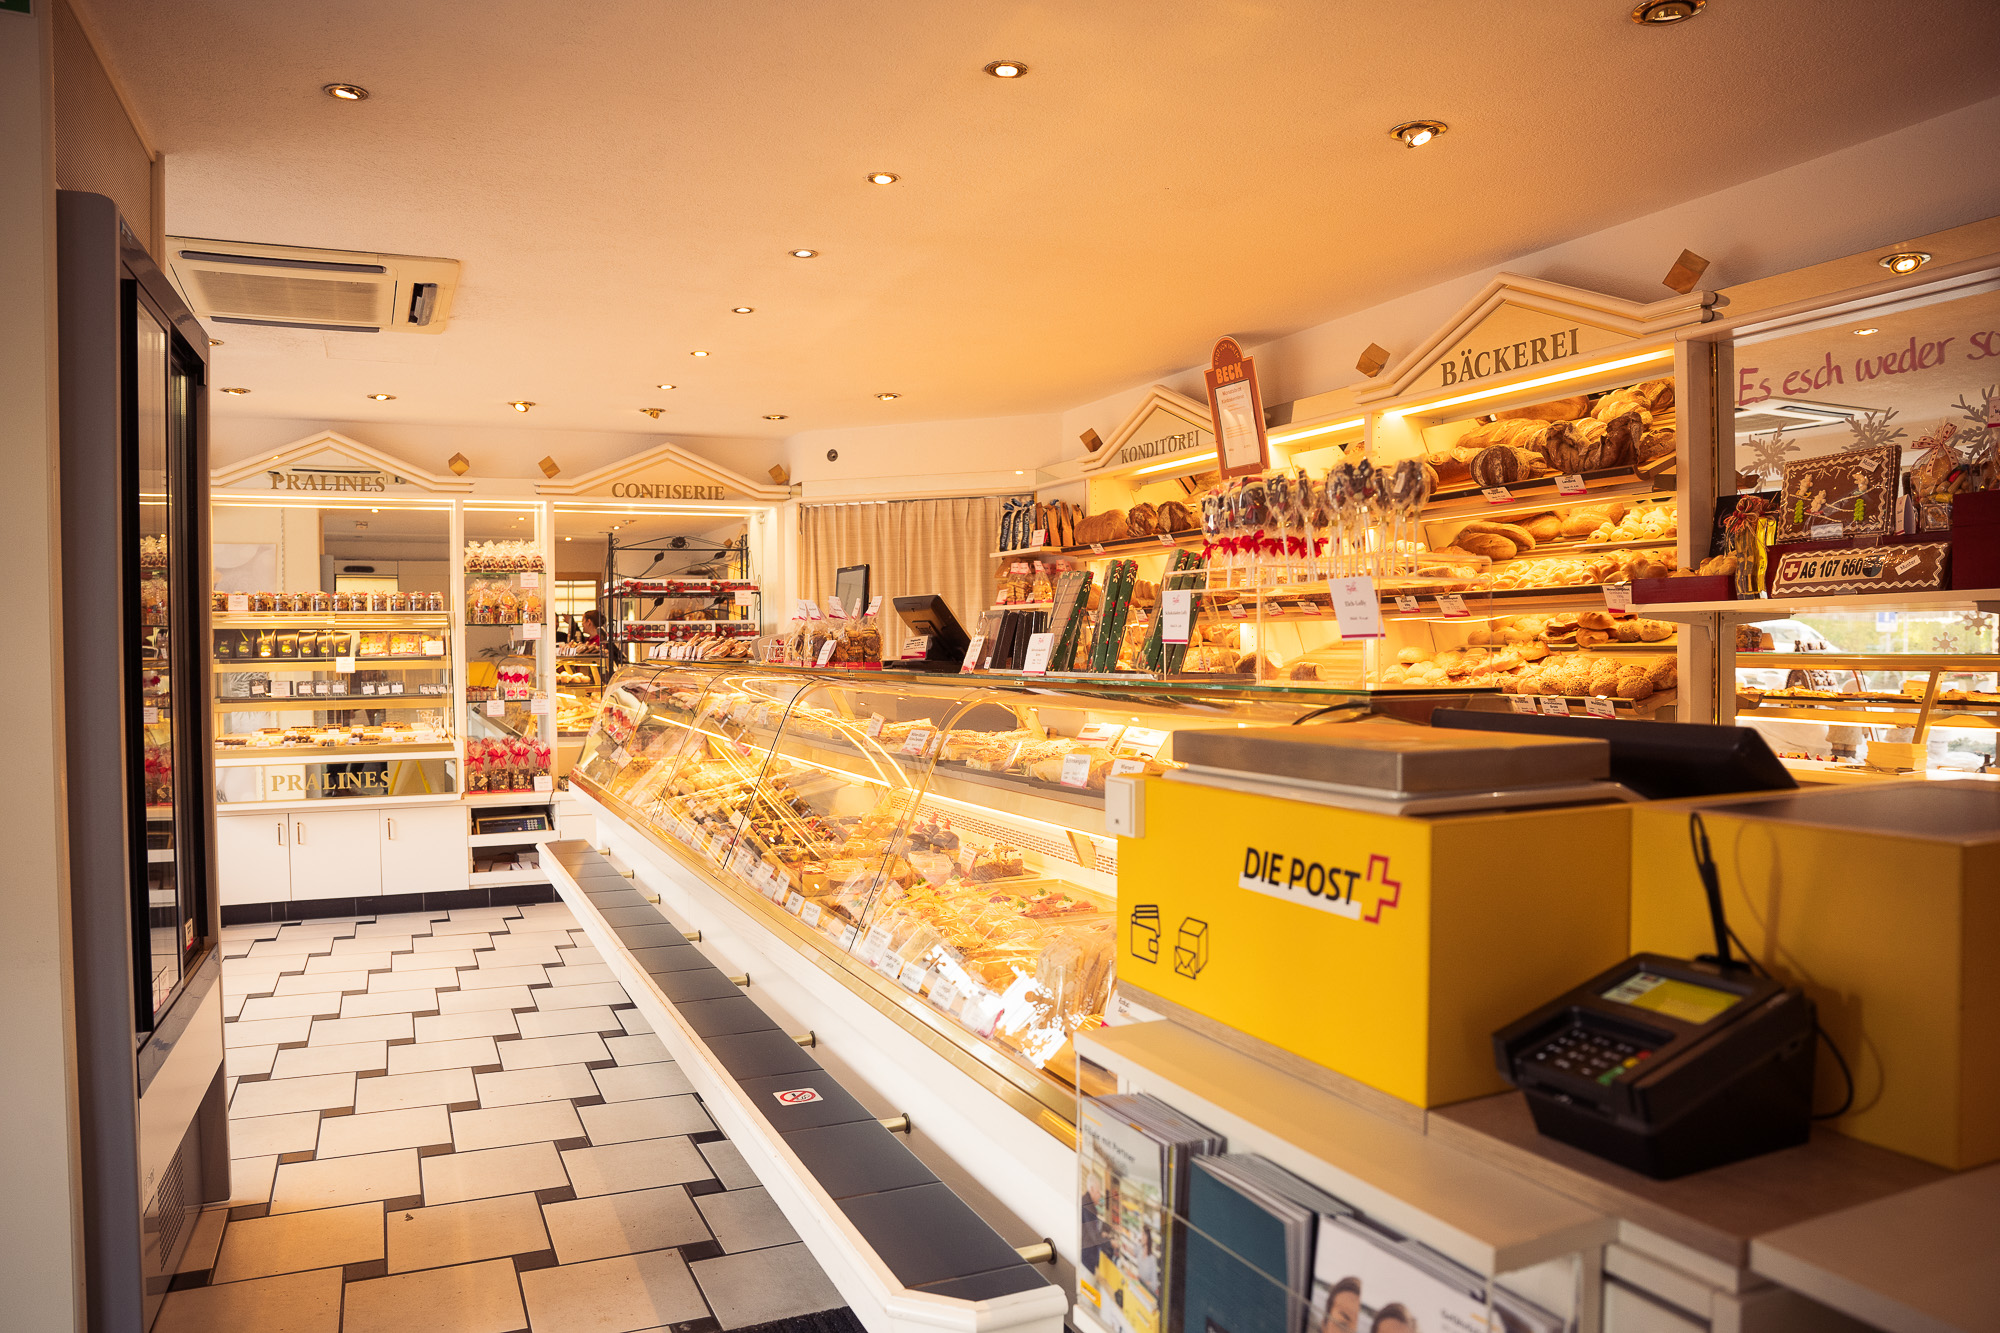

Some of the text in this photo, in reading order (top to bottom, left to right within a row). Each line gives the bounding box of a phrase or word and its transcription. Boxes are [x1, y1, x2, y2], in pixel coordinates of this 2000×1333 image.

[1440, 328, 1580, 387] BÄCKEREI
[1215, 361, 1243, 384] BECK
[1738, 367, 1772, 406] Es
[1782, 351, 1844, 396] esch
[1855, 336, 1956, 382] weder
[1120, 429, 1200, 464] KONDITOREI
[1862, 458, 1877, 469] Muster
[271, 473, 386, 493] PRALINES
[611, 481, 725, 501] CONFISERIE
[1799, 558, 1862, 579] AG 107 660
[1899, 559, 1917, 571] Muster
[271, 771, 391, 792] PRALINES
[1243, 846, 1361, 905] DIE POST
